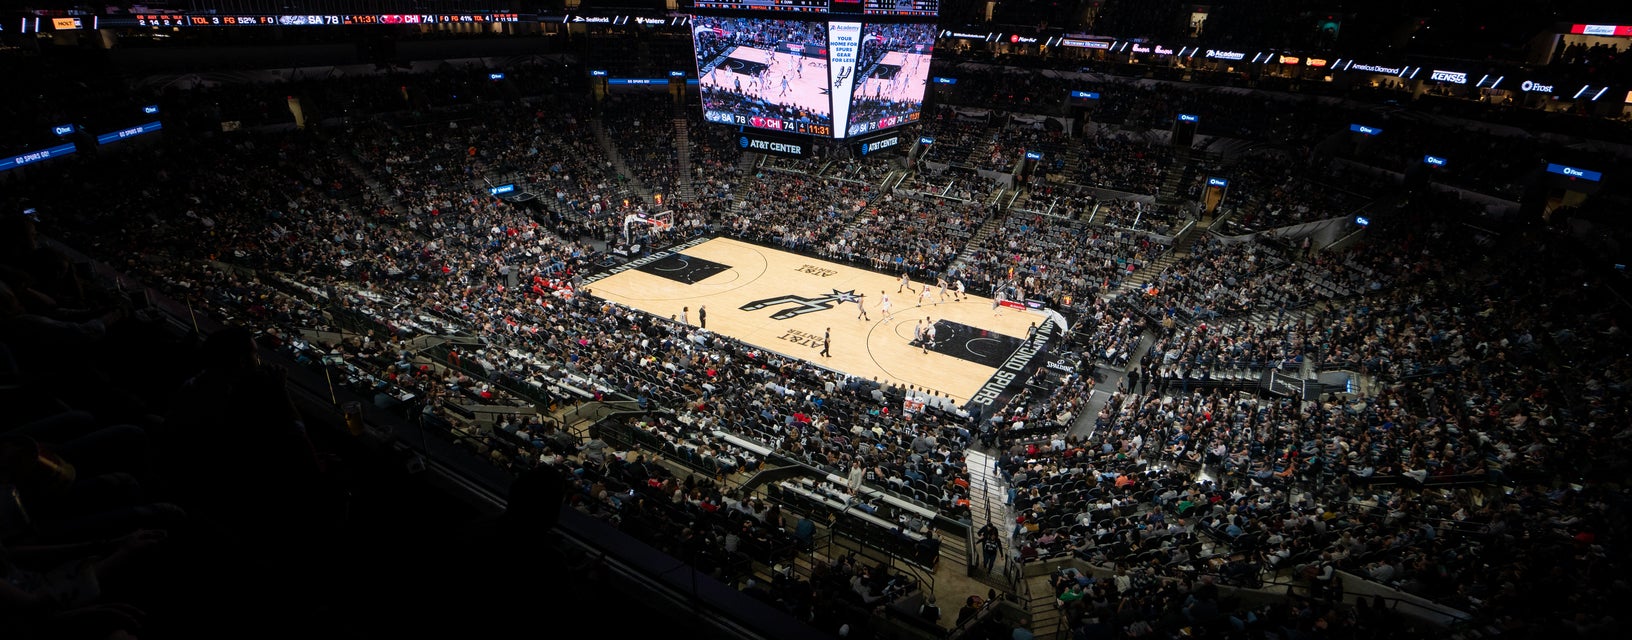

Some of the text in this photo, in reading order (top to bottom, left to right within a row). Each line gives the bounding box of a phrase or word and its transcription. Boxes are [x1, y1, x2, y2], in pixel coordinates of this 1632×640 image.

[308, 16, 323, 24] SA
[325, 16, 339, 24] 78
[404, 15, 418, 23] CHI
[422, 15, 433, 23] 74
[1352, 63, 1399, 74] Americus Diamond
[1533, 83, 1554, 92] Frost
[722, 113, 731, 121] SA
[735, 115, 745, 123] 78
[767, 120, 780, 128] CHI
[784, 122, 794, 130] 74
[809, 125, 829, 135] 11:31
[750, 140, 801, 154] AT&T CENTER
[868, 137, 898, 152] AT&T CENTER
[25, 152, 40, 162] SPURS
[581, 272, 609, 285] SAN
[609, 251, 669, 274] ANTONIO
[794, 267, 833, 277] AT&T
[777, 333, 824, 348] AT&T
[787, 329, 824, 342] ENTER
[1047, 360, 1074, 373] SPALDING
[973, 370, 1017, 406] SPURS
